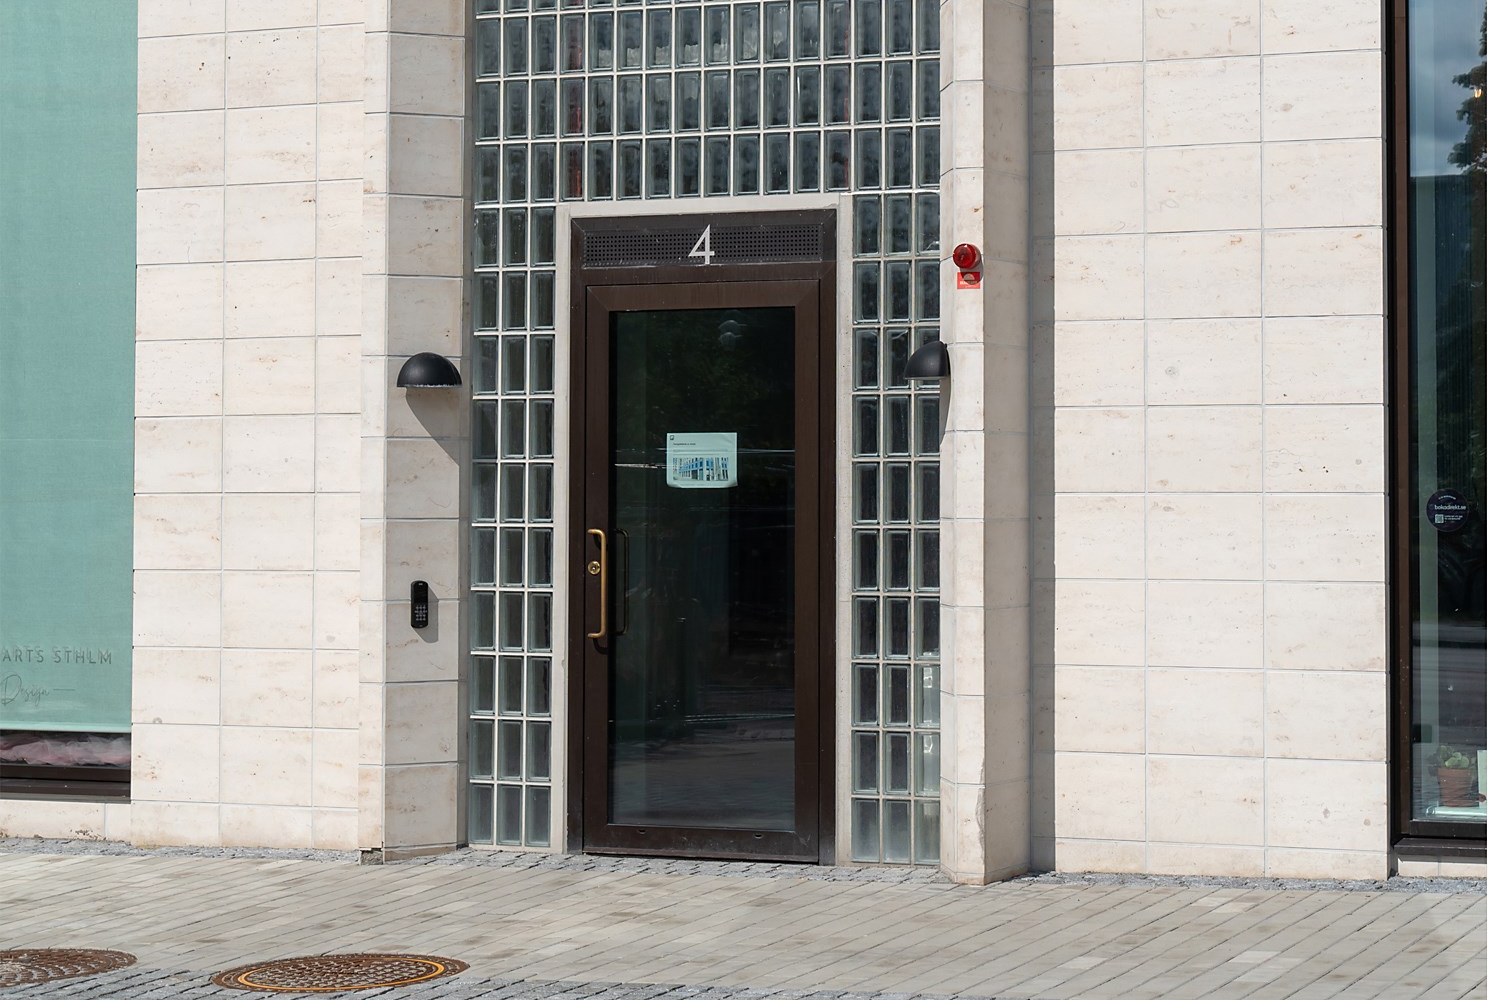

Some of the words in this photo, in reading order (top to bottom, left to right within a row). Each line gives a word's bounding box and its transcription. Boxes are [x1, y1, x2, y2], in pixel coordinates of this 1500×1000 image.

[688, 224, 715, 265] 4
[2, 649, 44, 663] ARTS
[53, 650, 112, 665] STHLM
[1, 673, 50, 707] Design
